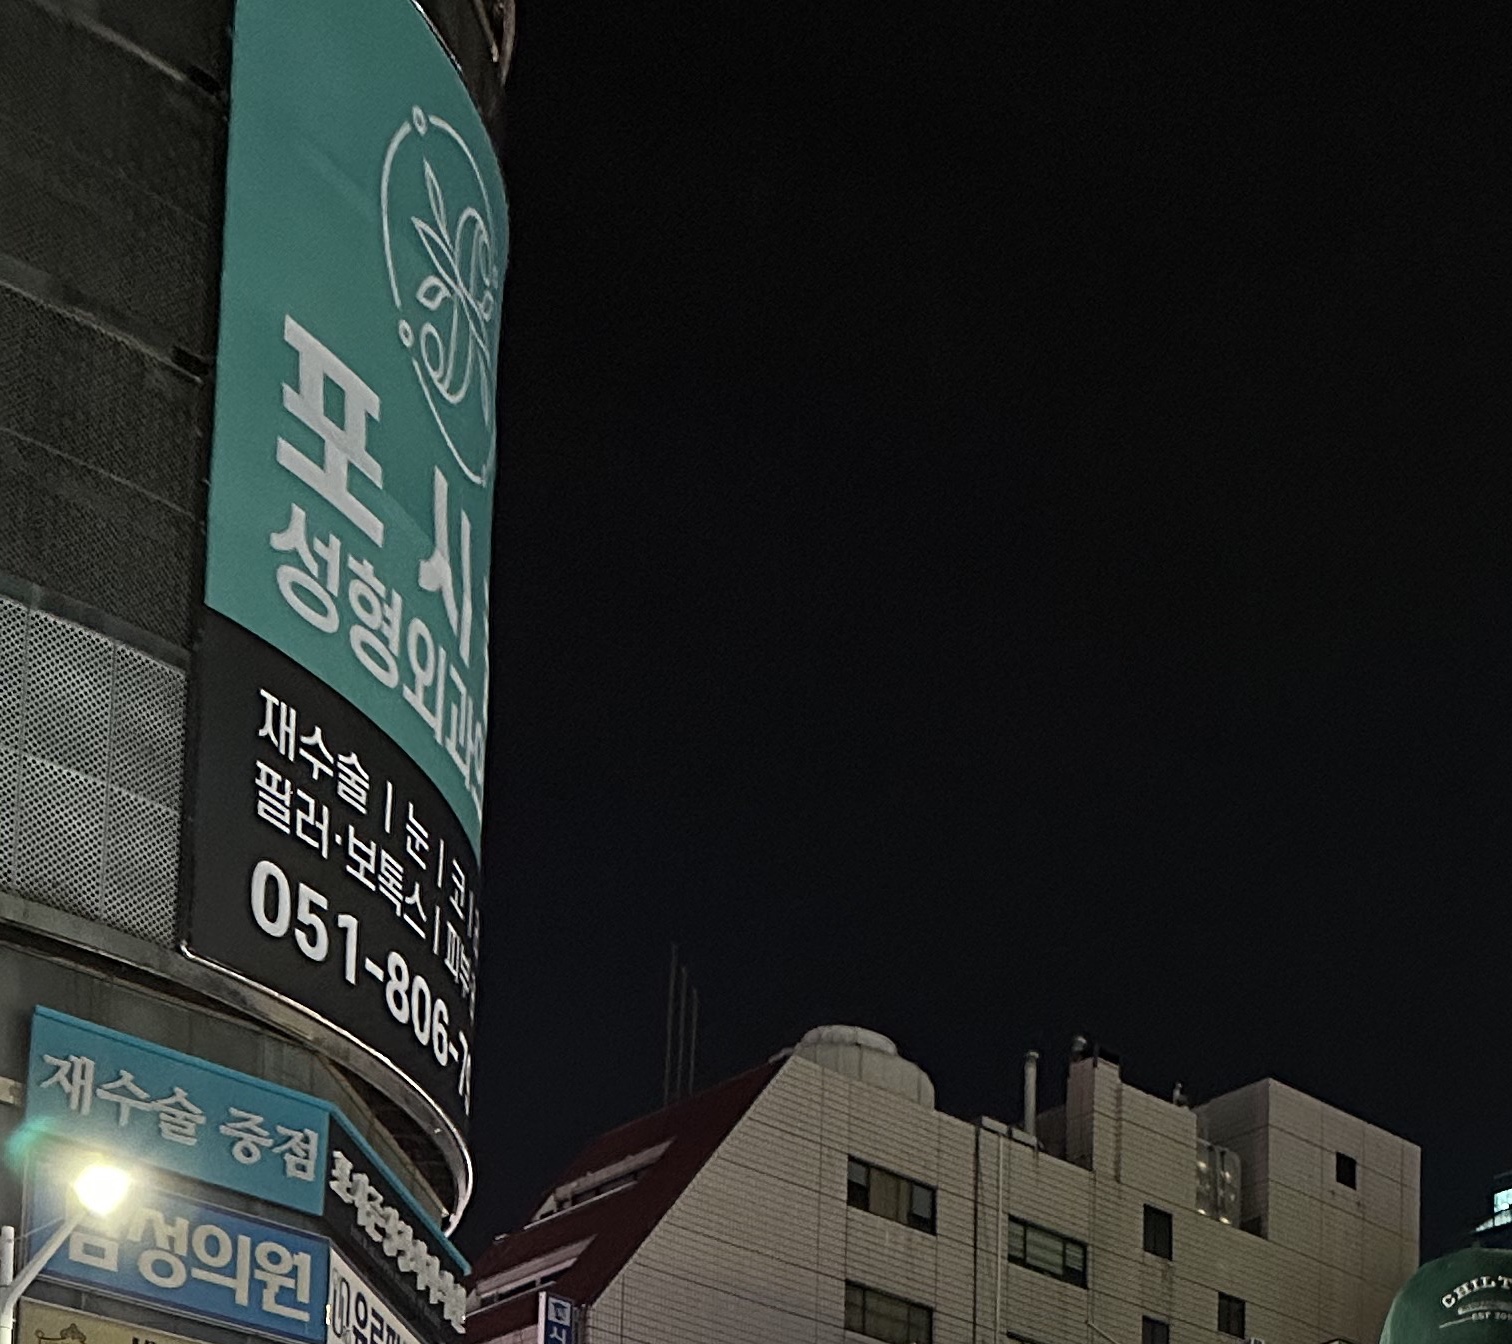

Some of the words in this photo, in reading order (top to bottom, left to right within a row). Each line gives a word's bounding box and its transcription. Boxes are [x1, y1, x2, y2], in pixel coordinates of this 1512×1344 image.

[260, 689, 369, 814] 재수술
[406, 801, 428, 871] 눈
[40, 1053, 206, 1146] 재수술
[219, 1106, 317, 1182] 중점
